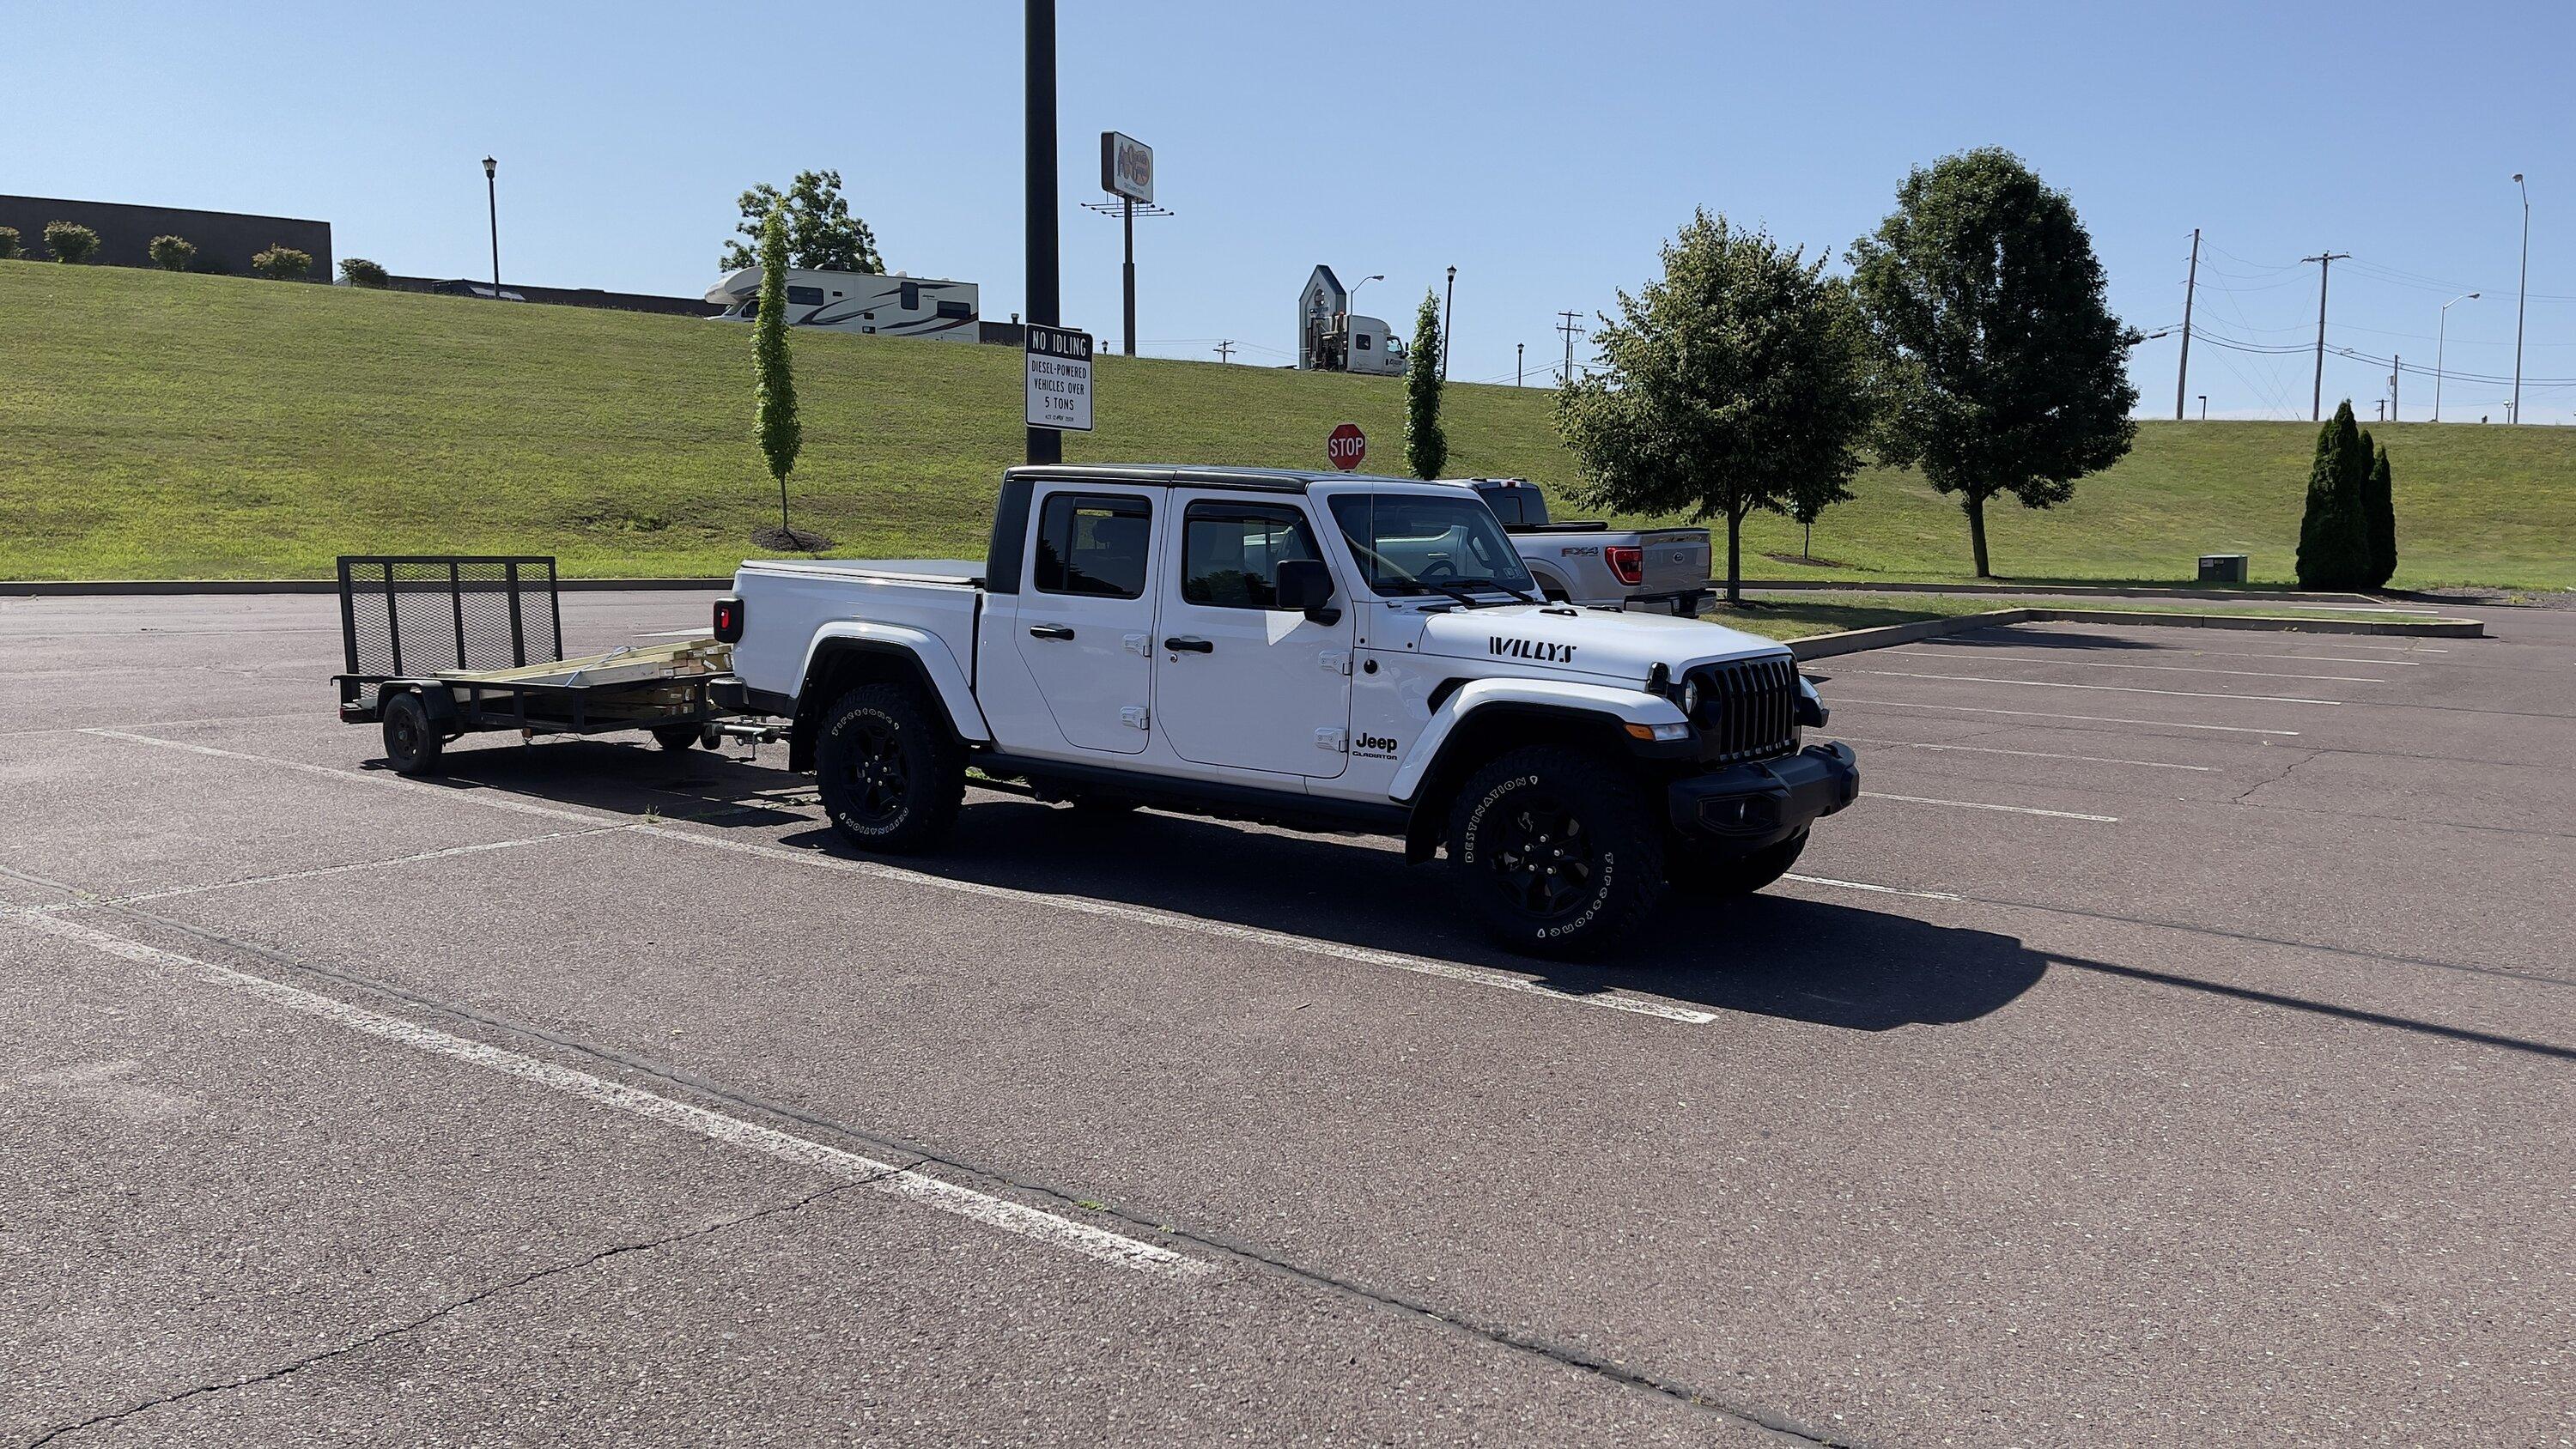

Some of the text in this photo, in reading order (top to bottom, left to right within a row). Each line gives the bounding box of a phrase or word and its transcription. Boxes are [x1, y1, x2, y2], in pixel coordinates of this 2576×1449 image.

[1032, 330, 1086, 357] NO IDLING
[1031, 360, 1087, 379] DIESEL-POWERED
[1034, 378, 1084, 396] VEHICLES OVER
[1045, 396, 1074, 410] 5 TONS
[1330, 437, 1364, 458] STOP
[1561, 546, 1599, 557] FX4
[1489, 636, 1577, 664] WILLYS
[1356, 732, 1398, 753] Jeep
[1352, 750, 1398, 761] GLADIATOR
[846, 806, 909, 835] DESTINATION
[1465, 777, 1527, 863] DESTINATION
